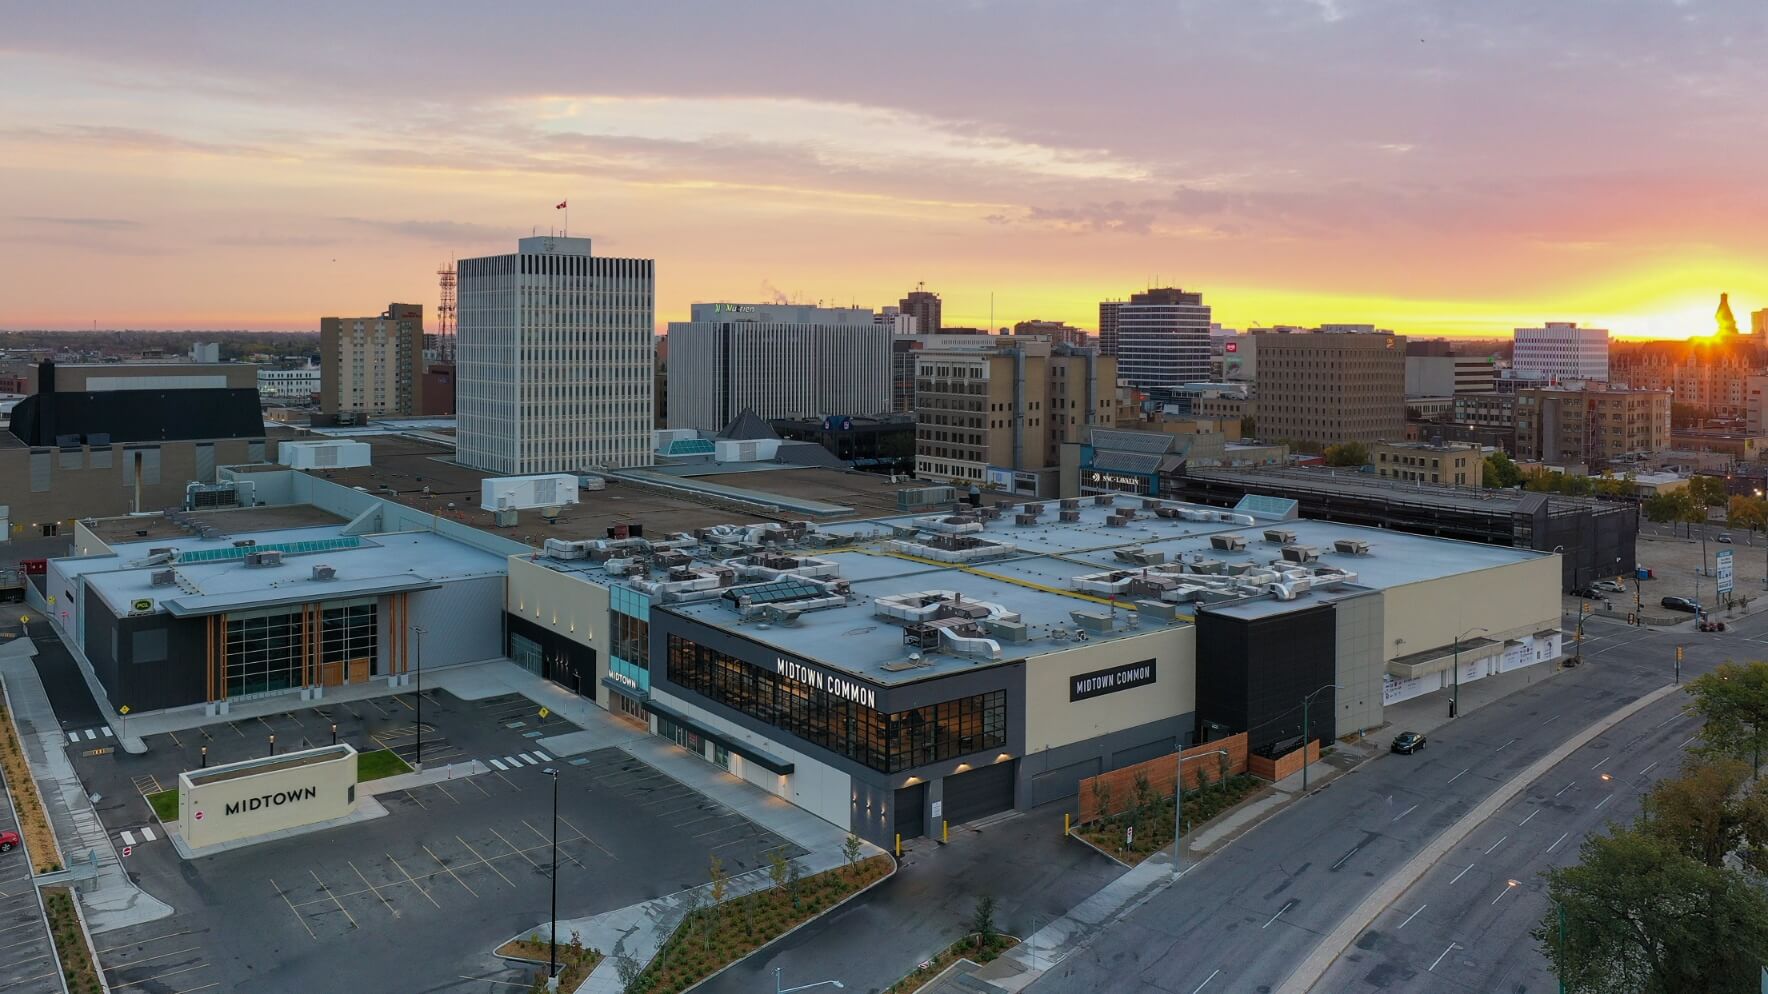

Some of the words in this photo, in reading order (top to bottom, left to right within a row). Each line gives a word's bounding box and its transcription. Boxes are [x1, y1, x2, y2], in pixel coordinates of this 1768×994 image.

[726, 304, 755, 312] Nurien
[608, 669, 636, 688] MIDTOWN
[777, 657, 823, 690] MIDTOWN
[827, 675, 875, 709] COMMON
[1076, 674, 1114, 694] MIDTOWN
[1117, 665, 1150, 685] COMMON
[225, 786, 316, 816] MIDTOWN
